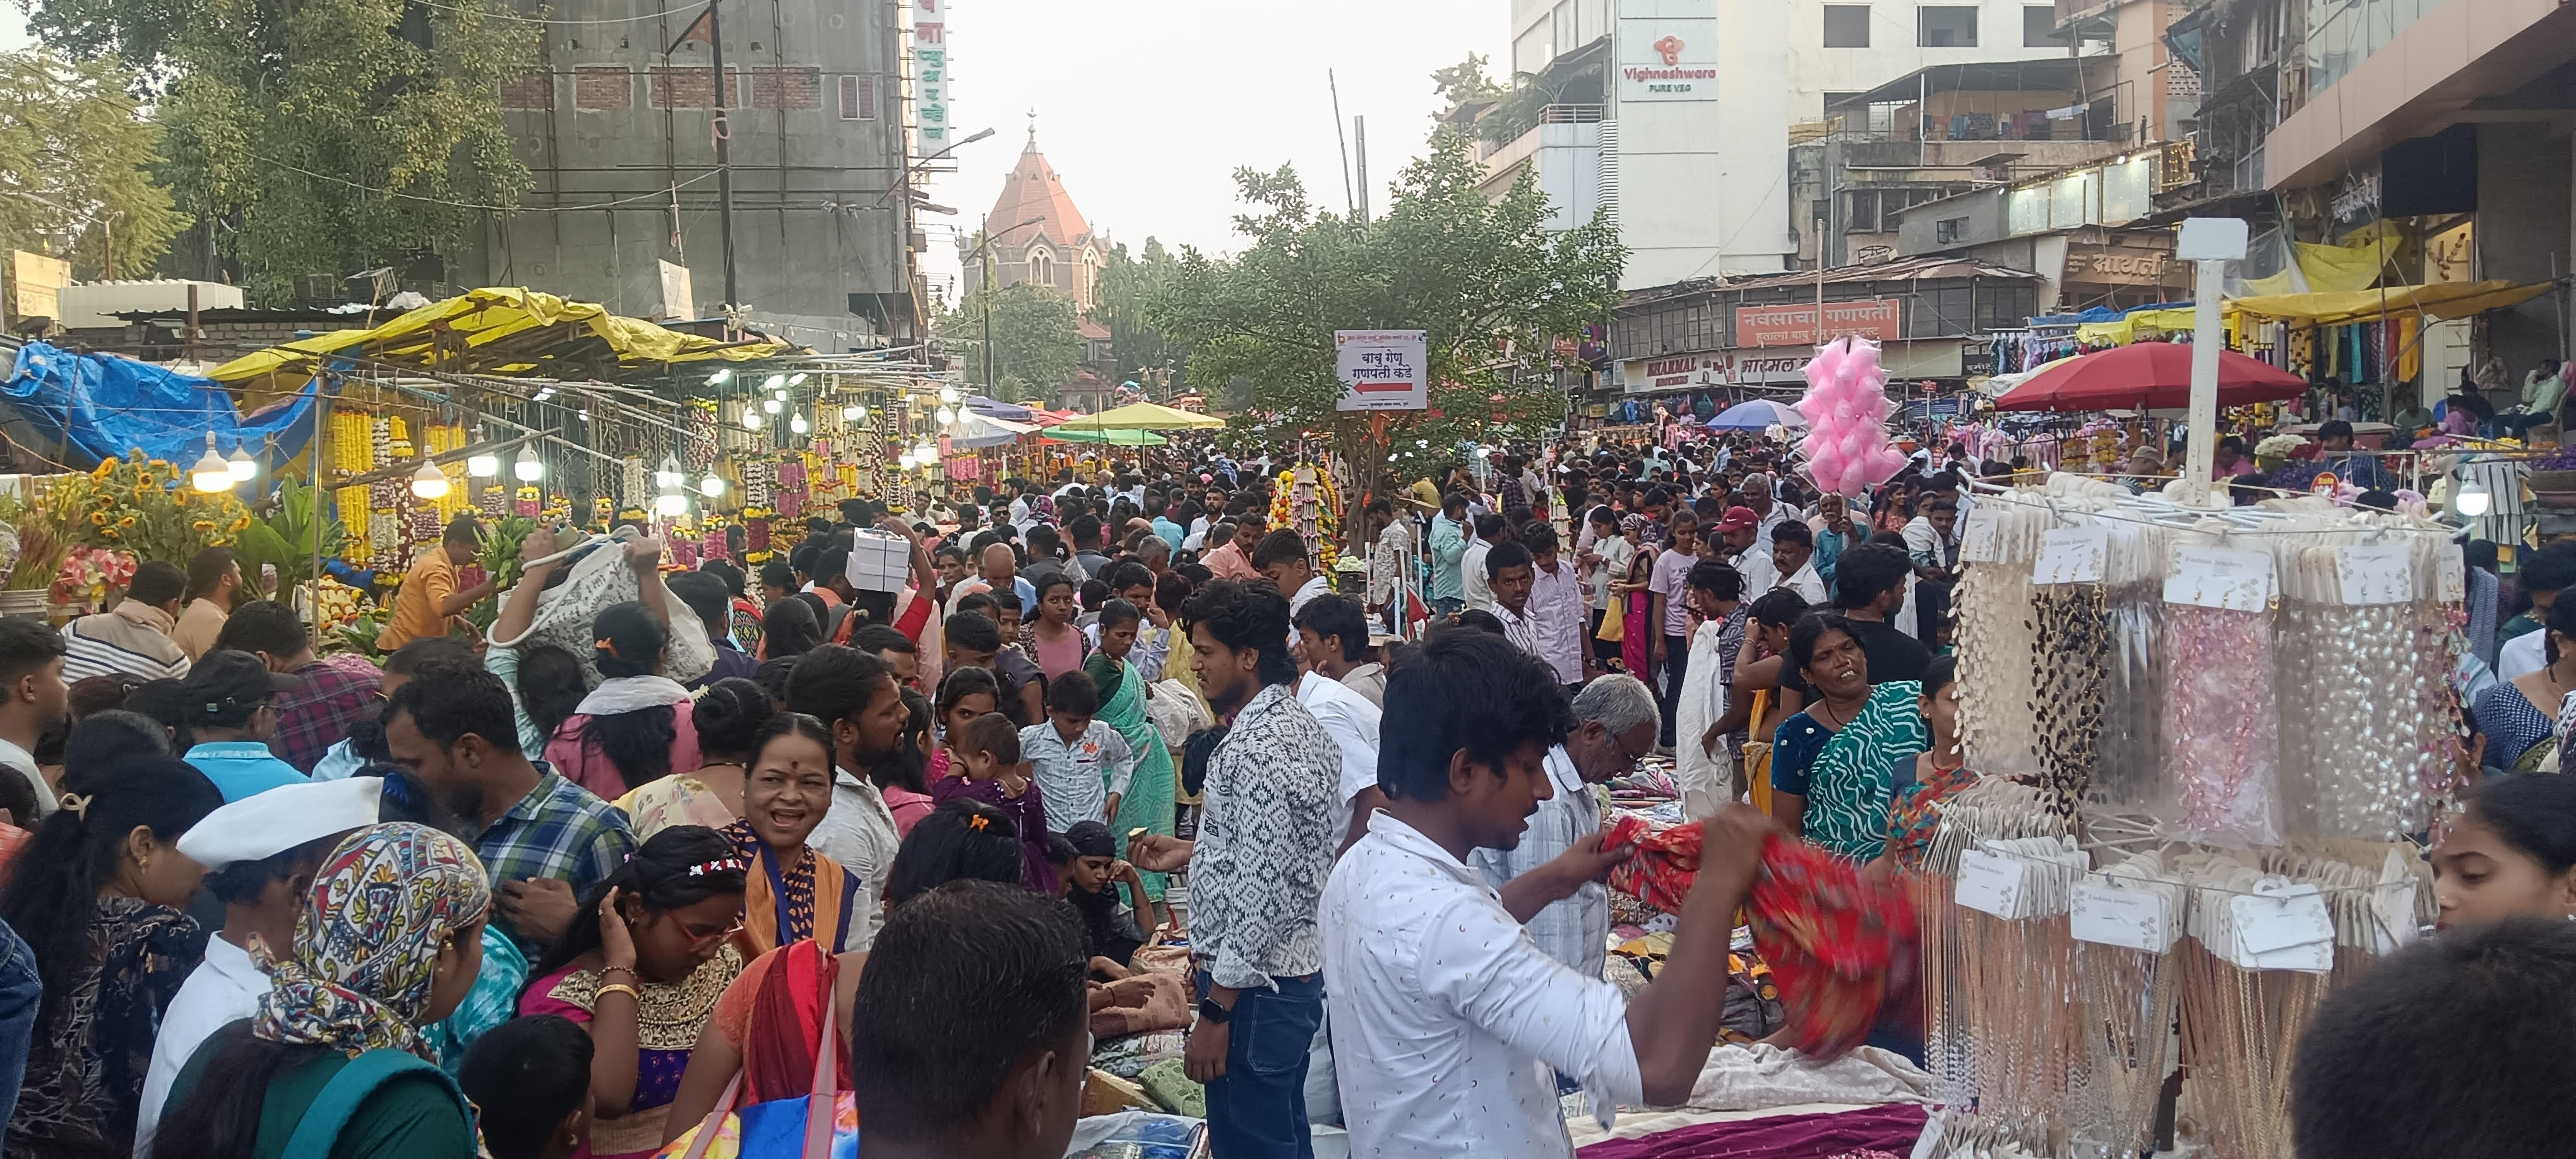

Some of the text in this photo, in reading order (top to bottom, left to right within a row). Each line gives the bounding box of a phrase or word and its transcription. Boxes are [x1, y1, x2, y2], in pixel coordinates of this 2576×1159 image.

[1624, 67, 1716, 83] Vighneshwara
[1649, 84, 1691, 92] PURE VEG
[1742, 302, 1893, 327] नवसाचा गणपती
[1352, 364, 1413, 379] गणपती कडे
